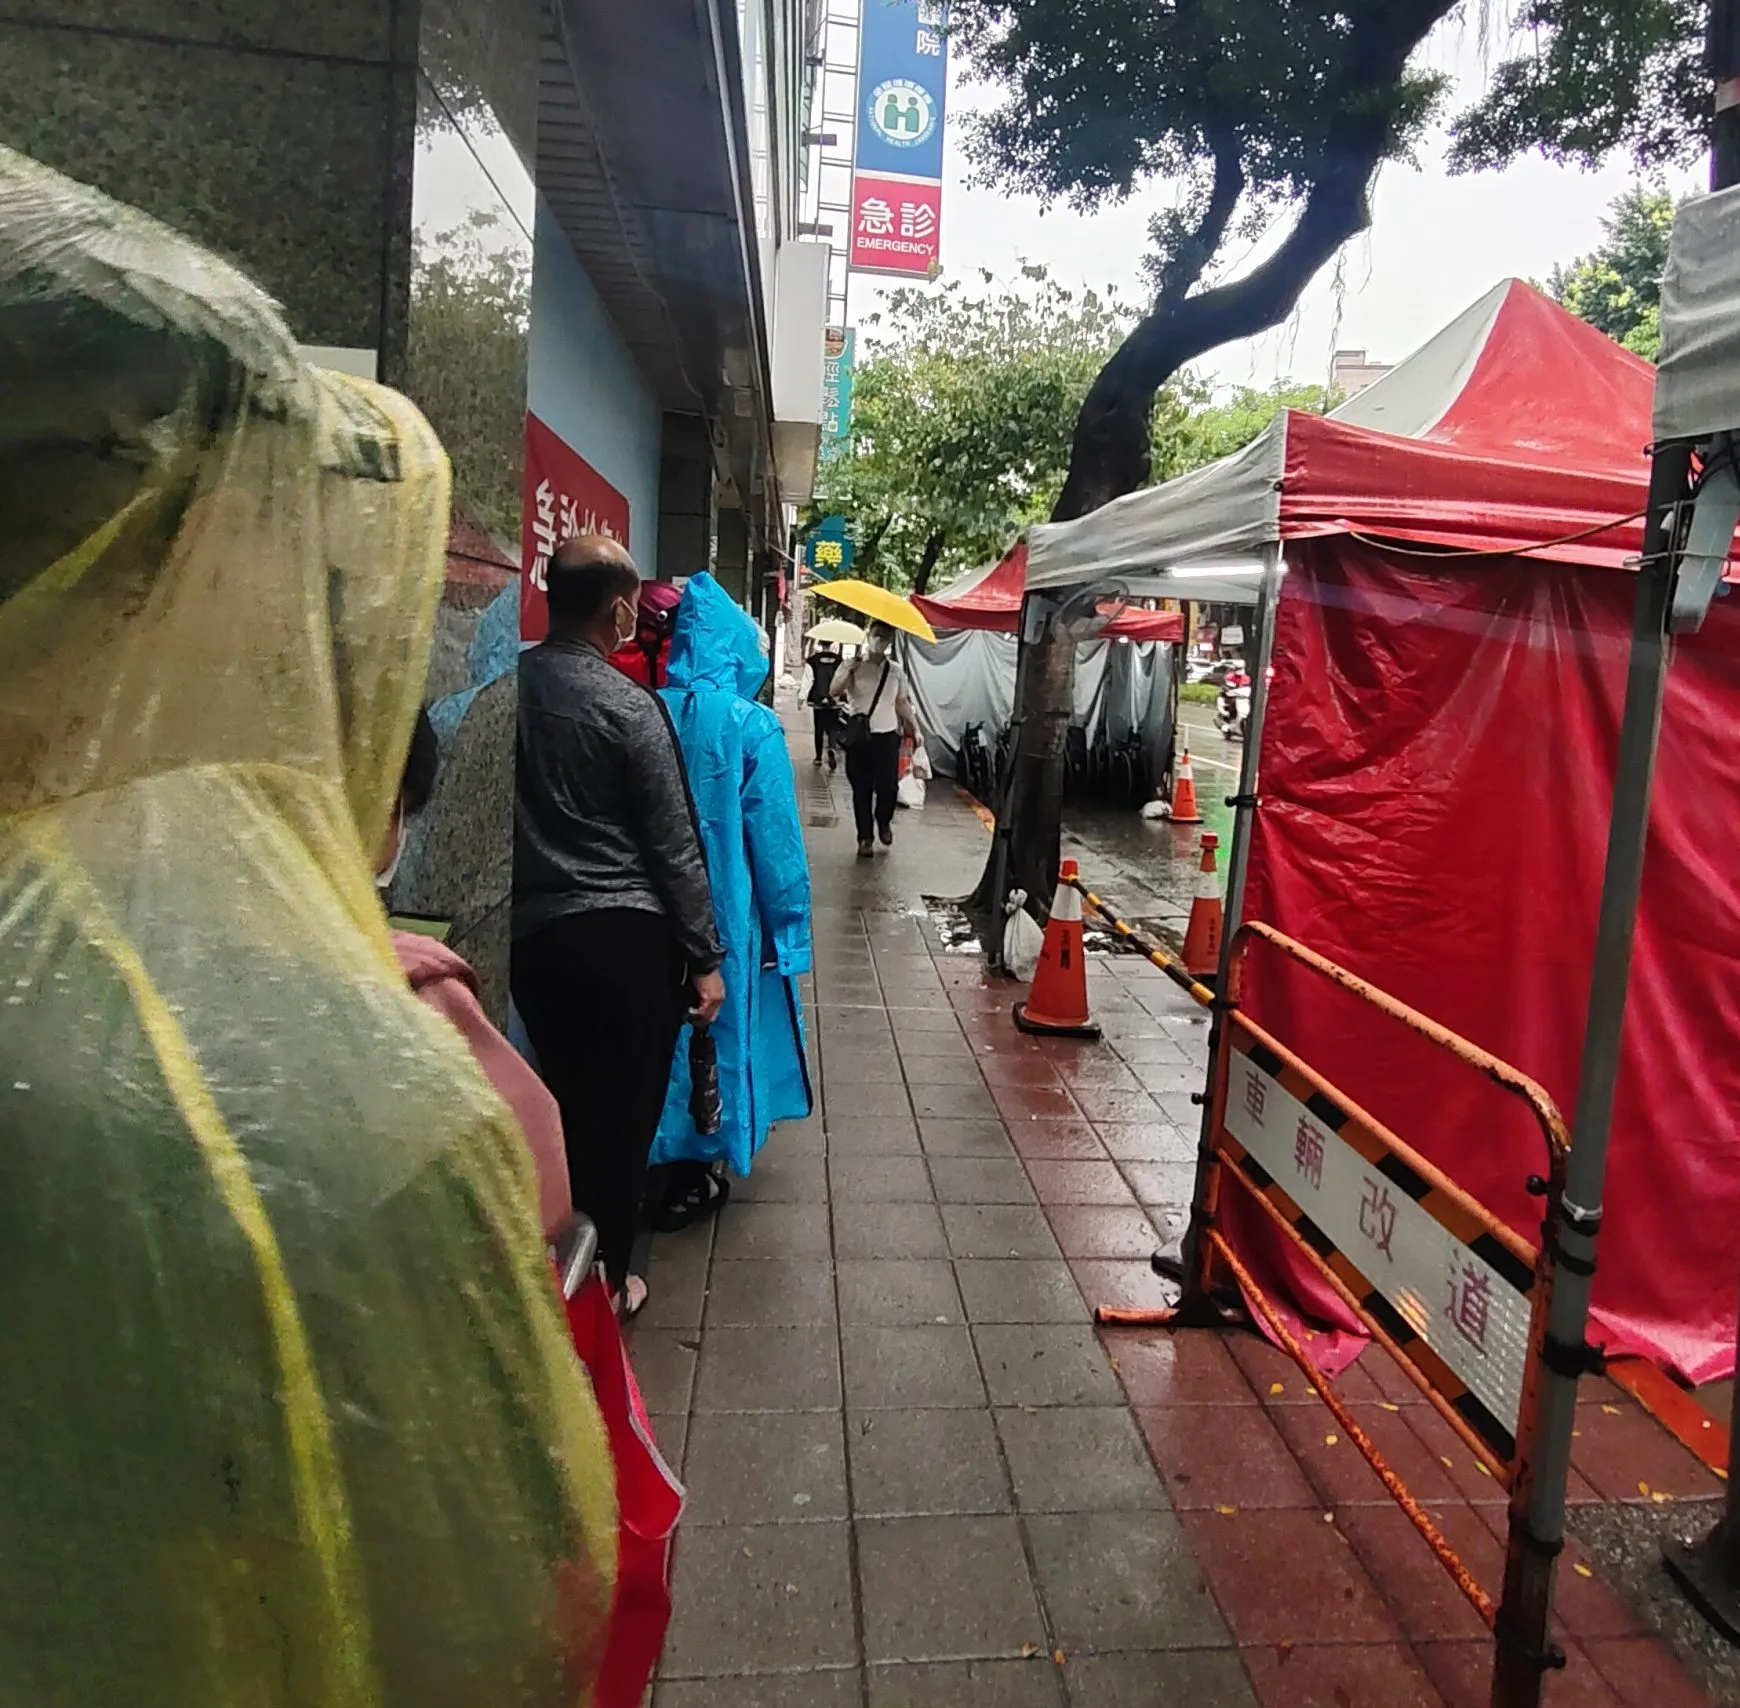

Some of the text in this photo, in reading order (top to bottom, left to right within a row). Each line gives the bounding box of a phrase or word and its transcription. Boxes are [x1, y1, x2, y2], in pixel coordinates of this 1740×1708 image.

[858, 196, 937, 239] 急診
[856, 237, 935, 256] EMERGENCY
[814, 540, 843, 568] 藥
[1245, 1069, 1494, 1357] 車輛改道
